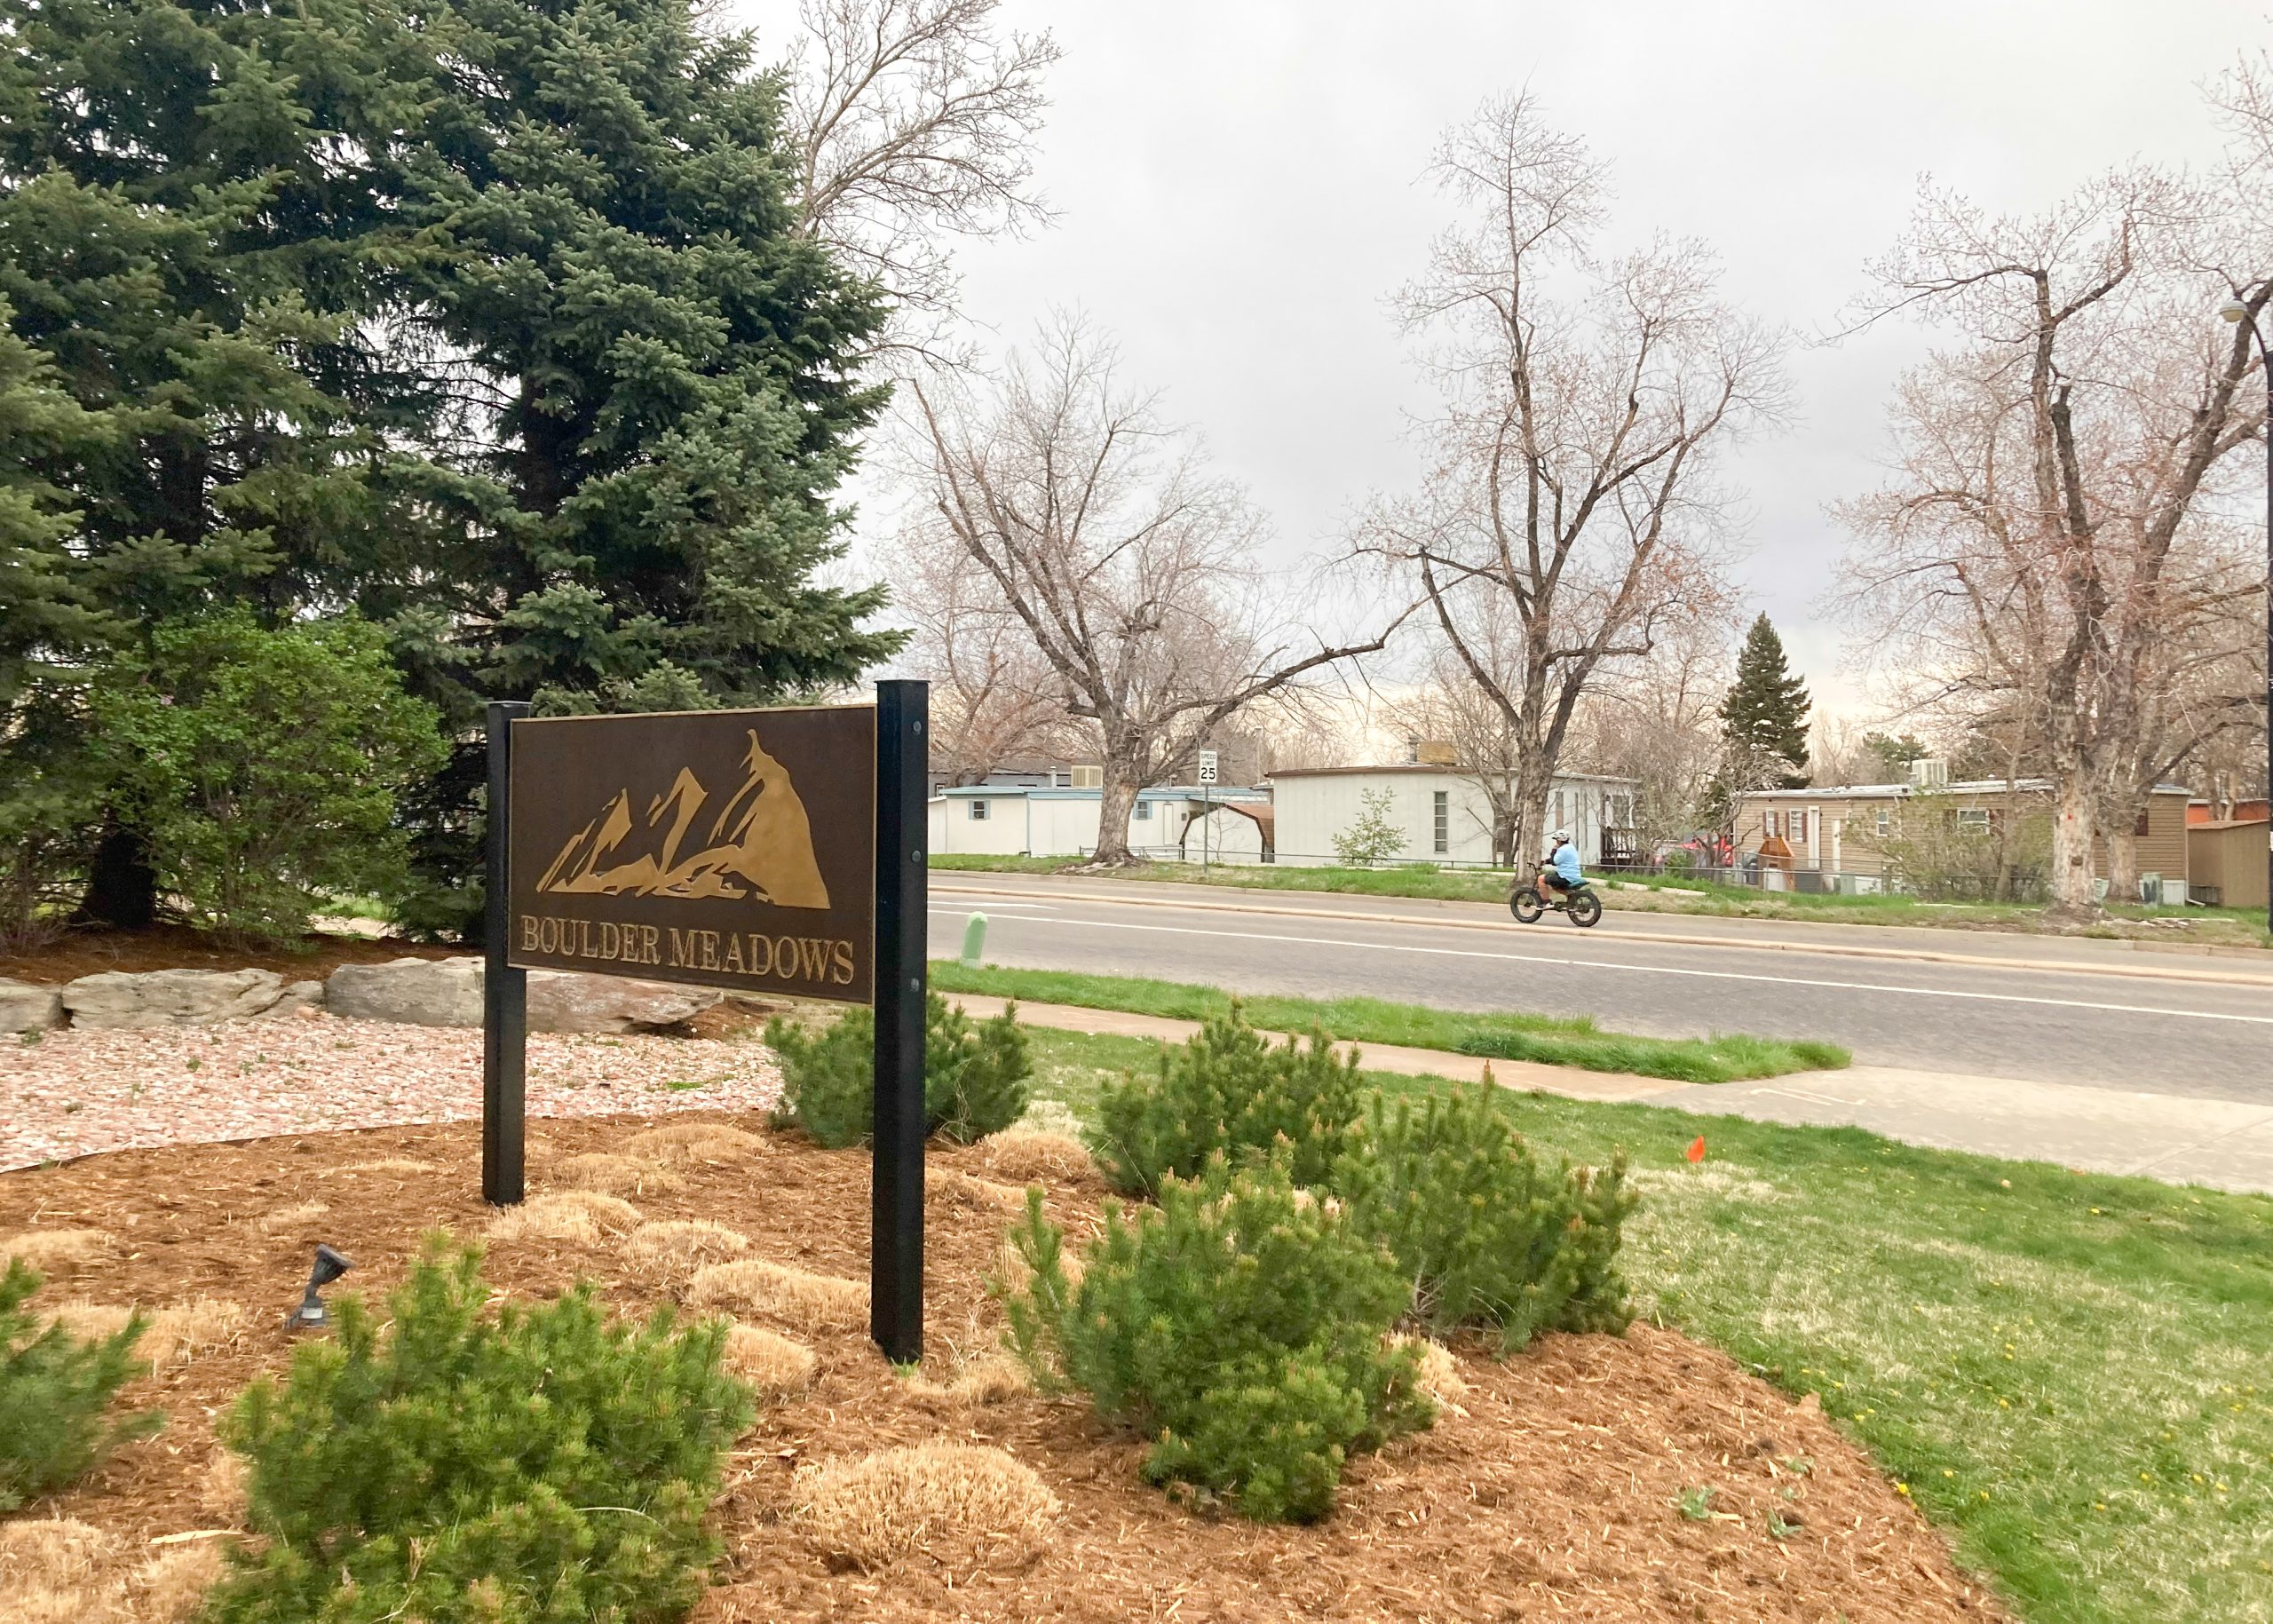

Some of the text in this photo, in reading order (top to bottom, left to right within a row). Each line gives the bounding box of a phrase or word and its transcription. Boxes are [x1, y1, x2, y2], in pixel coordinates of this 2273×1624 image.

[1200, 766, 1216, 780] 25
[520, 915, 855, 986] BOULDER MEADOWS
